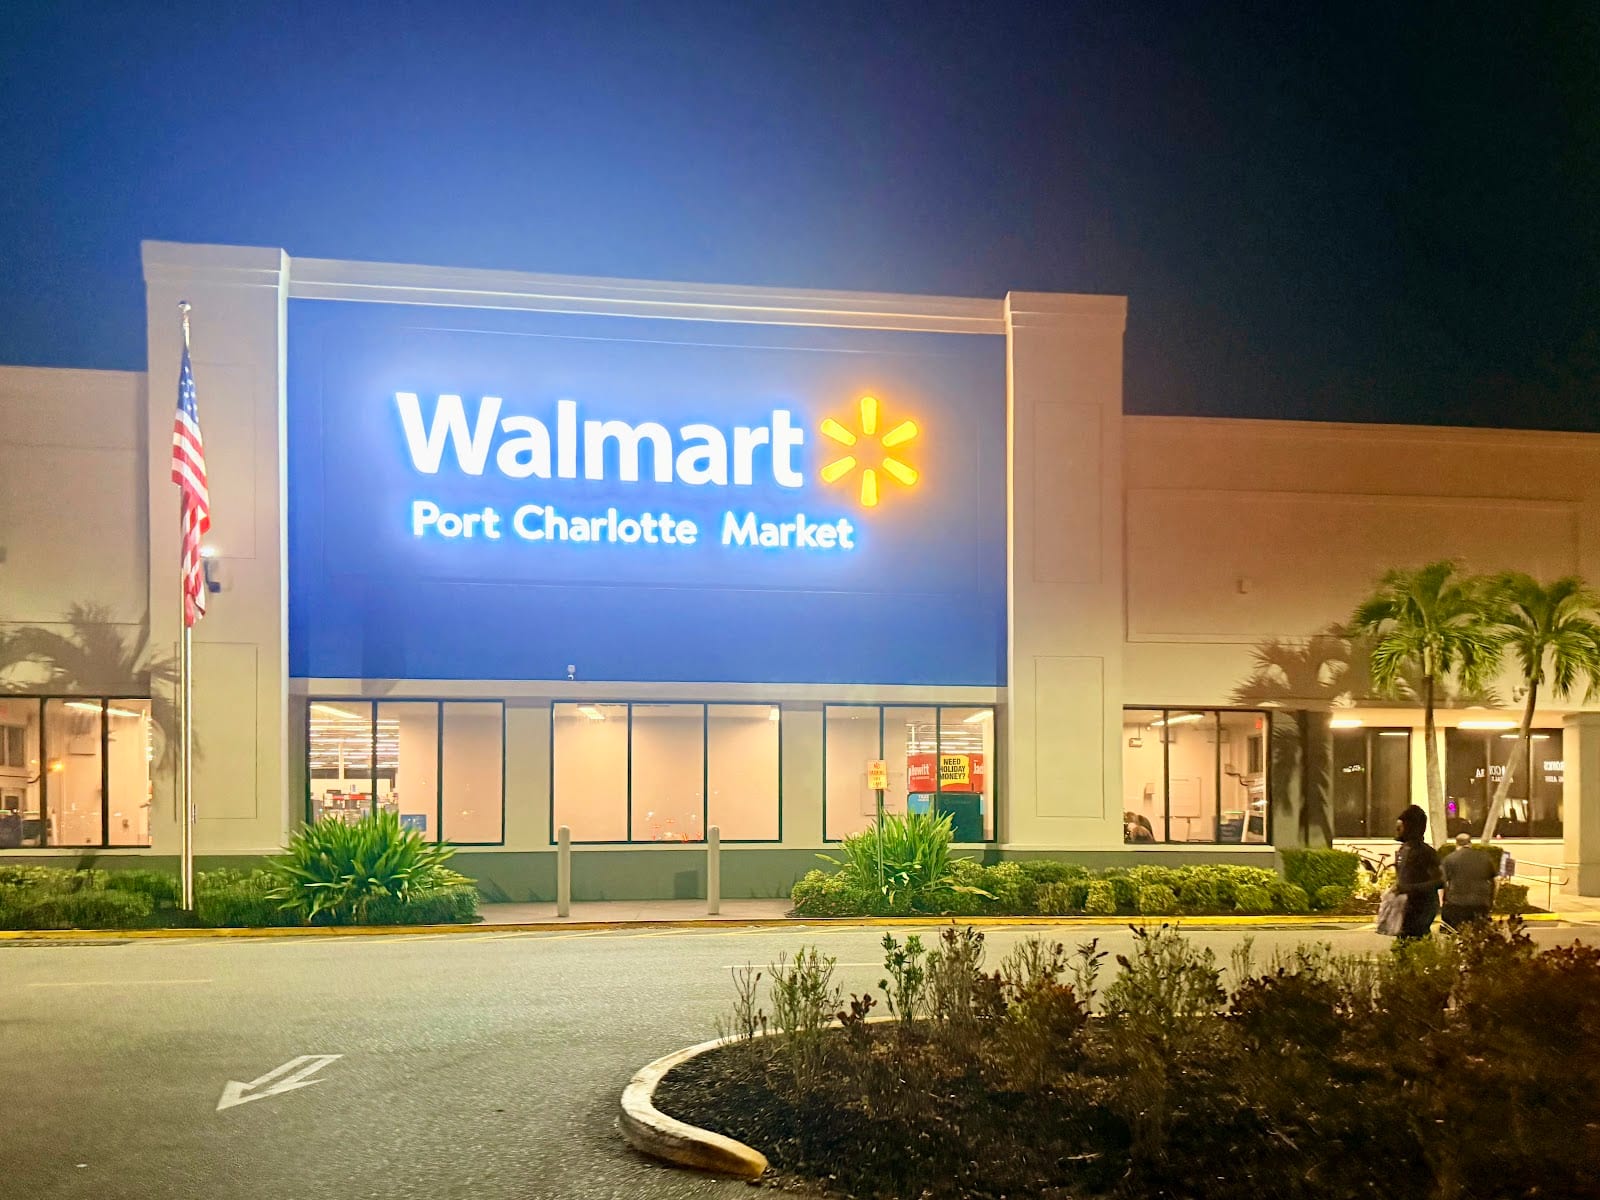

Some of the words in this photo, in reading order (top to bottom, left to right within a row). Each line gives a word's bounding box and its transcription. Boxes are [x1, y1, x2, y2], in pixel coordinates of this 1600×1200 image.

[395, 392, 804, 488] Walmart
[412, 500, 501, 539] Port
[513, 504, 698, 545] Charlotte
[721, 511, 854, 549] Market
